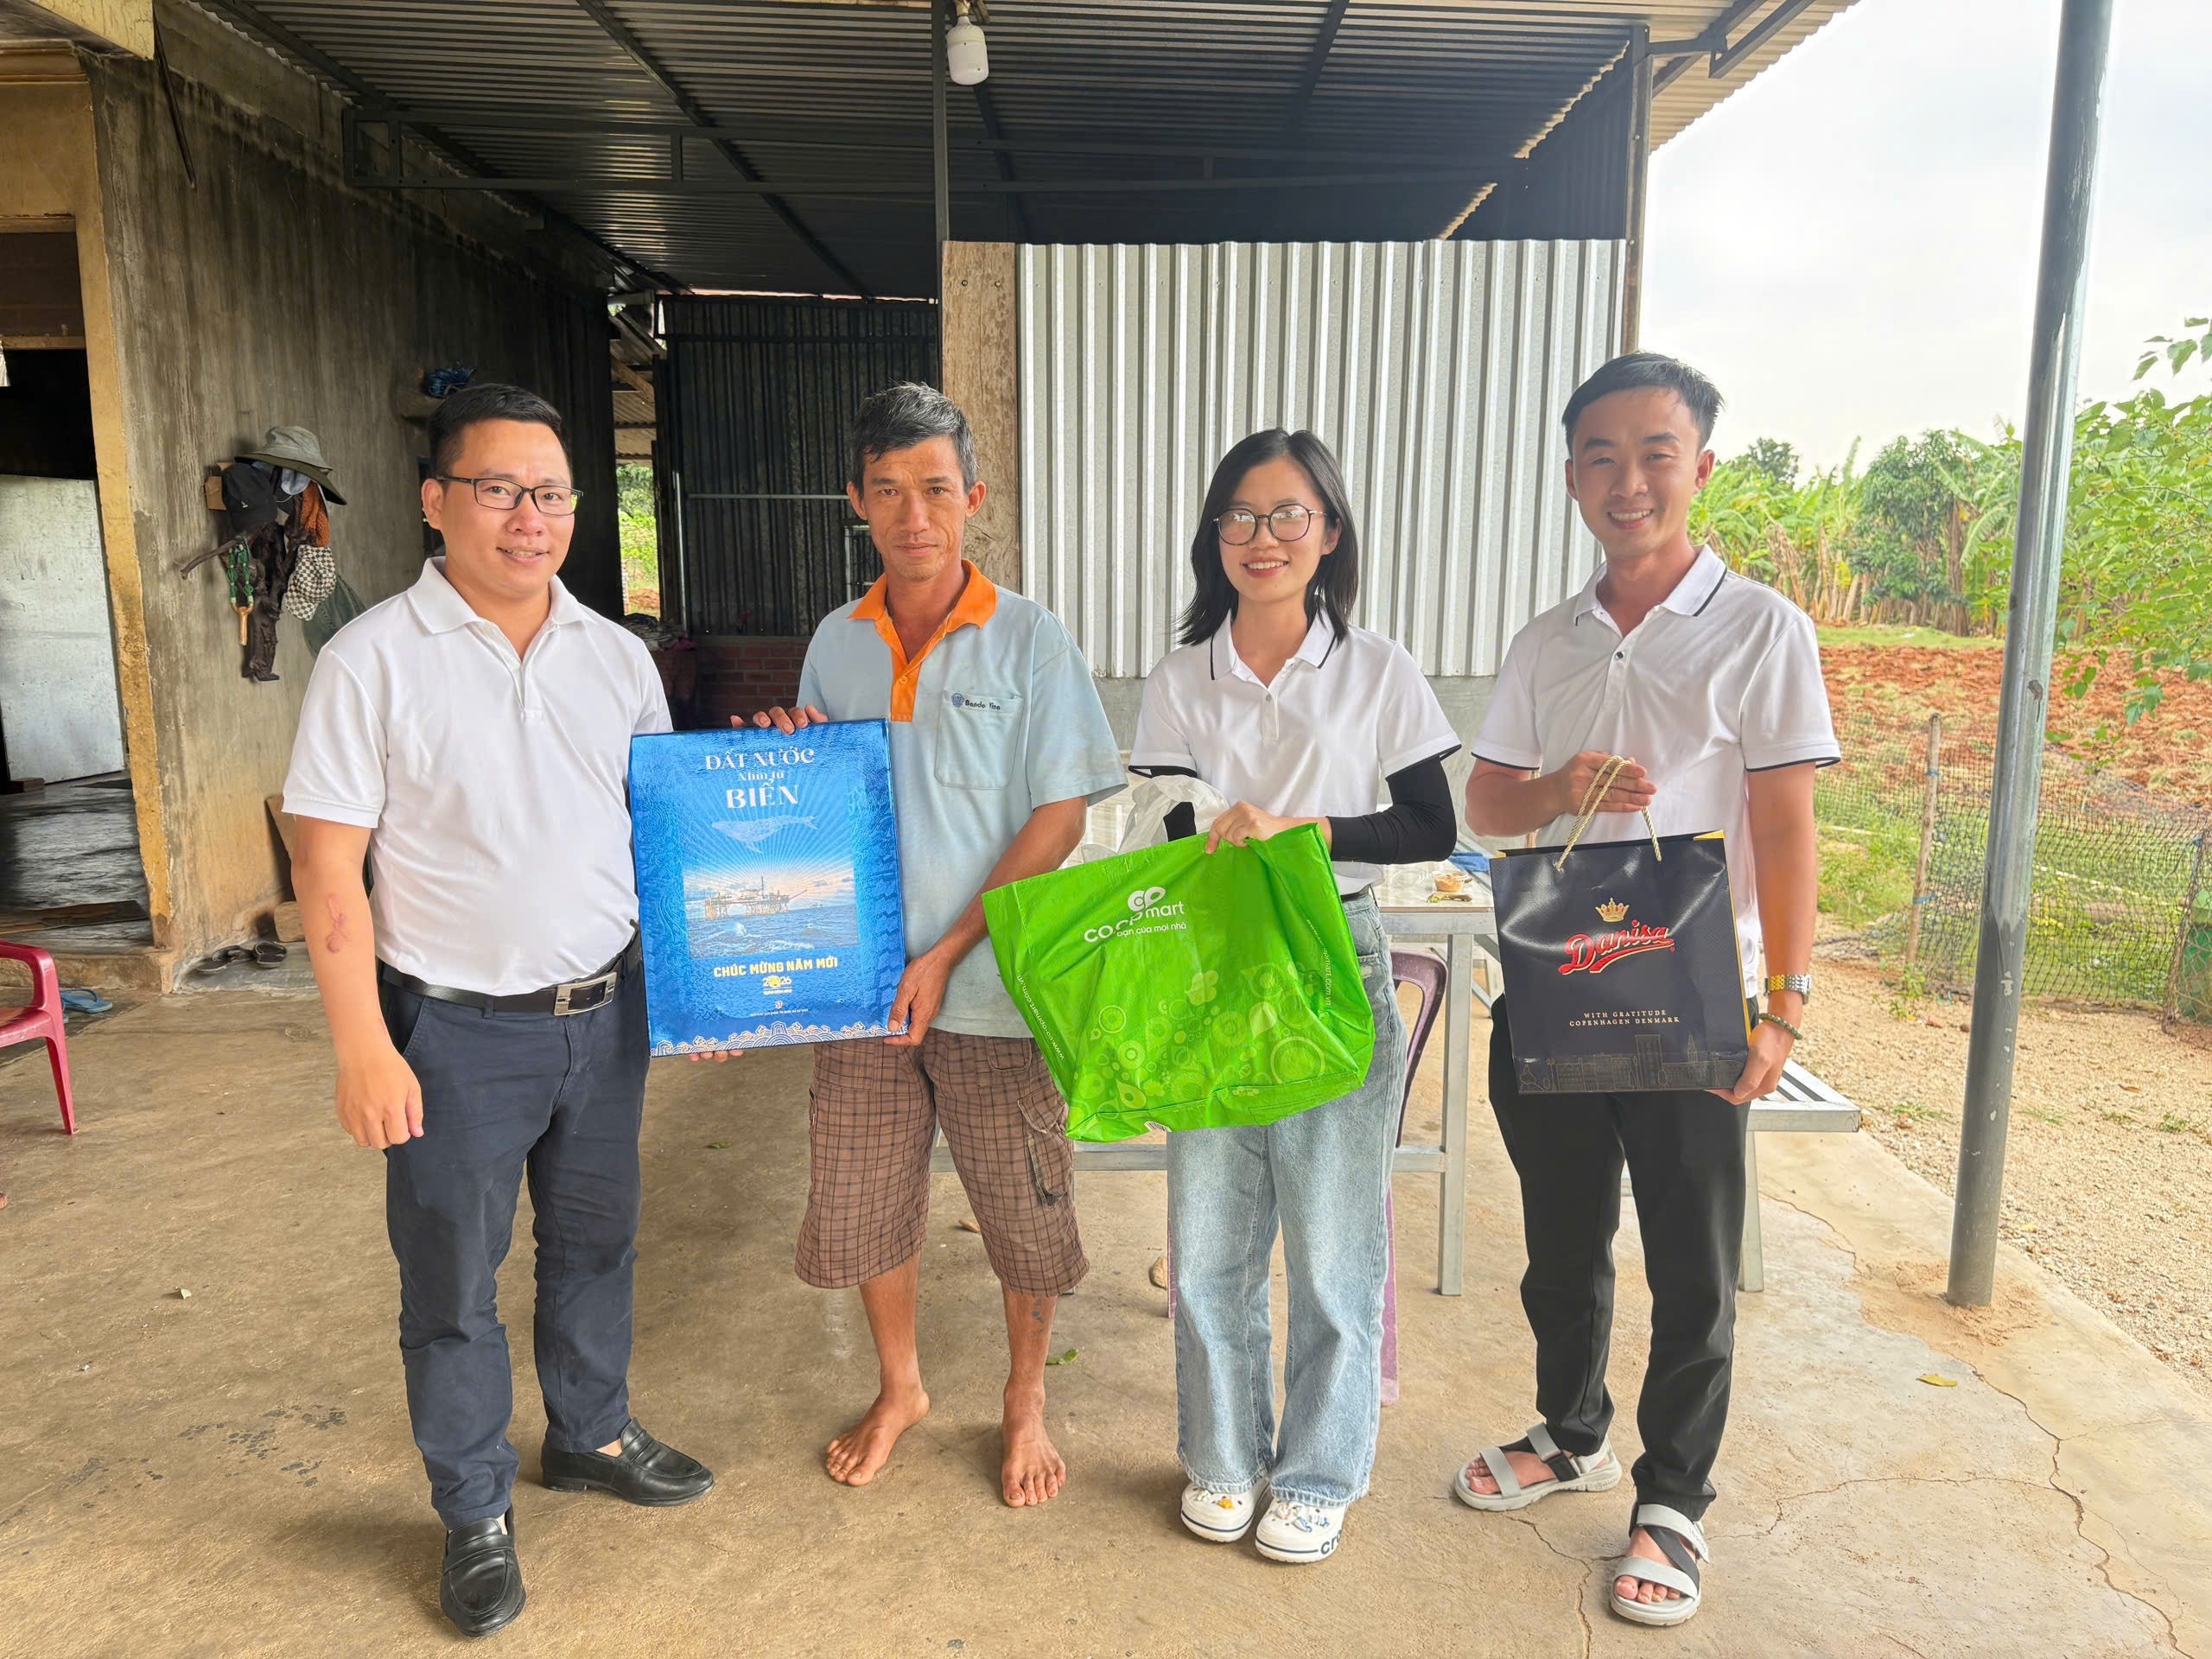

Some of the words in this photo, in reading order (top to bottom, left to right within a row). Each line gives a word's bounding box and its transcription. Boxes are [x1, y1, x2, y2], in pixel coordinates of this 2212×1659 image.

[1558, 919, 1675, 976] Danisa
[713, 963, 747, 978] CHÚC
[786, 957, 814, 971] NĂM
[1569, 1019, 1630, 1027] COPENHAGEN
[1635, 1016, 1681, 1025] DENMARK
[1612, 1009, 1667, 1018] GRATITUDE
